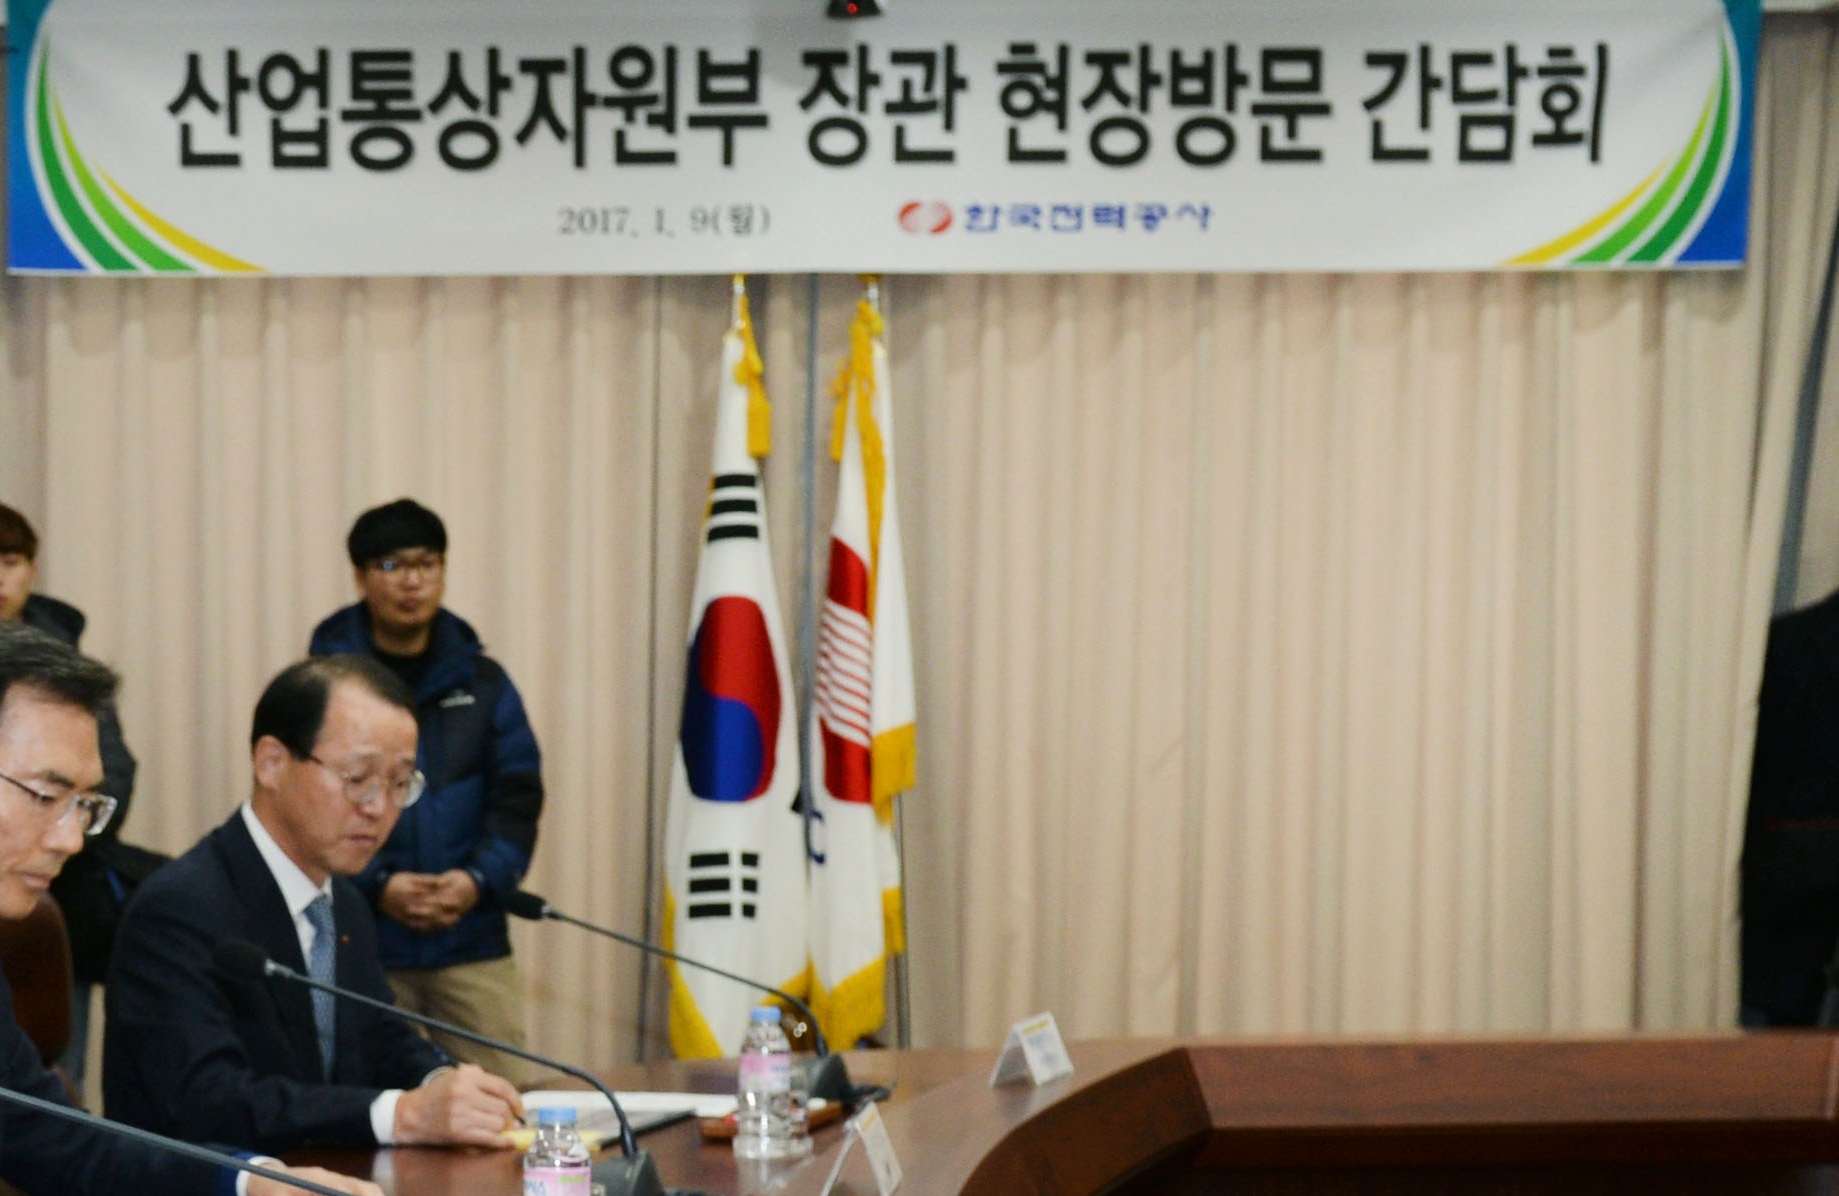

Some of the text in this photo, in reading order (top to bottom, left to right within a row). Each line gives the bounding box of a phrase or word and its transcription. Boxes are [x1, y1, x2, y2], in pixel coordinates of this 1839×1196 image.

[167, 42, 1608, 171] 산업통상자원부 장관 현장방문 간담회
[964, 204, 1212, 232] 한국전력공사
